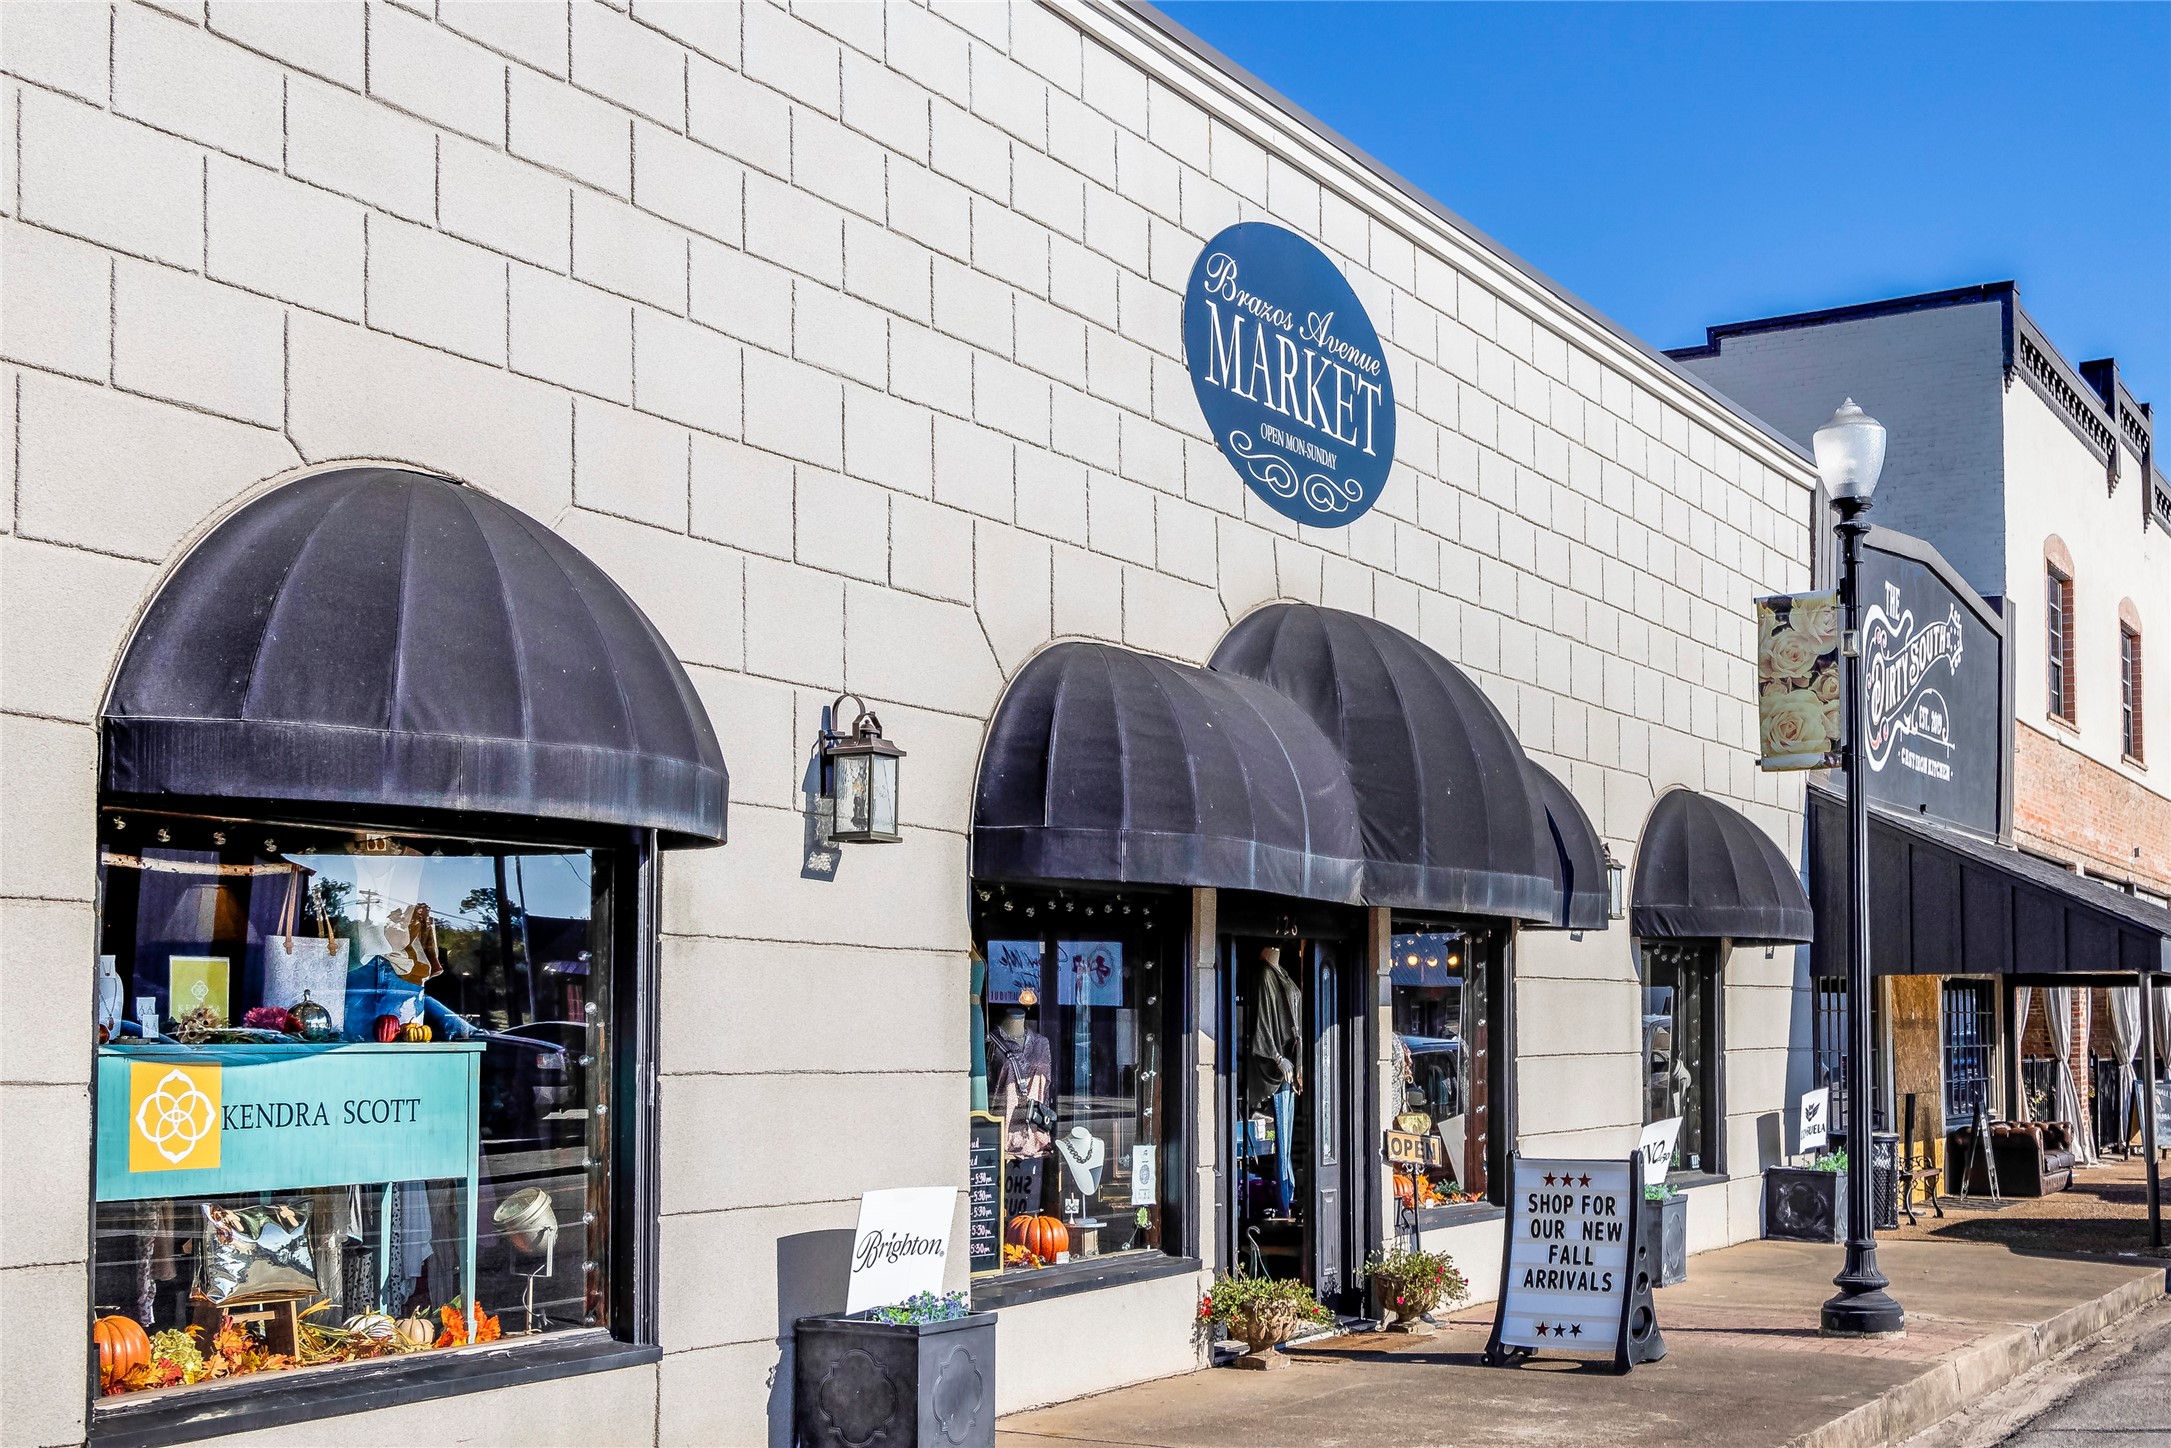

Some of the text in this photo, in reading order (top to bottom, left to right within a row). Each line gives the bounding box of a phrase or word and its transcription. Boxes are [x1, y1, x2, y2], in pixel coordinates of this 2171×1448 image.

[1204, 252, 1381, 376] Brazos Avenue
[1204, 299, 1382, 457] MARKET
[1260, 422, 1337, 471] OPEN MON-SUNDAY
[1884, 579, 1901, 621] THE
[1871, 624, 1947, 726] DIRTY SOUTH
[221, 1098, 421, 1130] KENDRA SCOTT
[1391, 1137, 1436, 1161] OPEN
[1528, 1193, 1616, 1217] SHOP FOR
[1530, 1218, 1623, 1242] OUR NEW
[853, 1229, 942, 1273] Brighton
[1548, 1244, 1594, 1266] FALL
[1523, 1268, 1613, 1293] ARRIVALS
